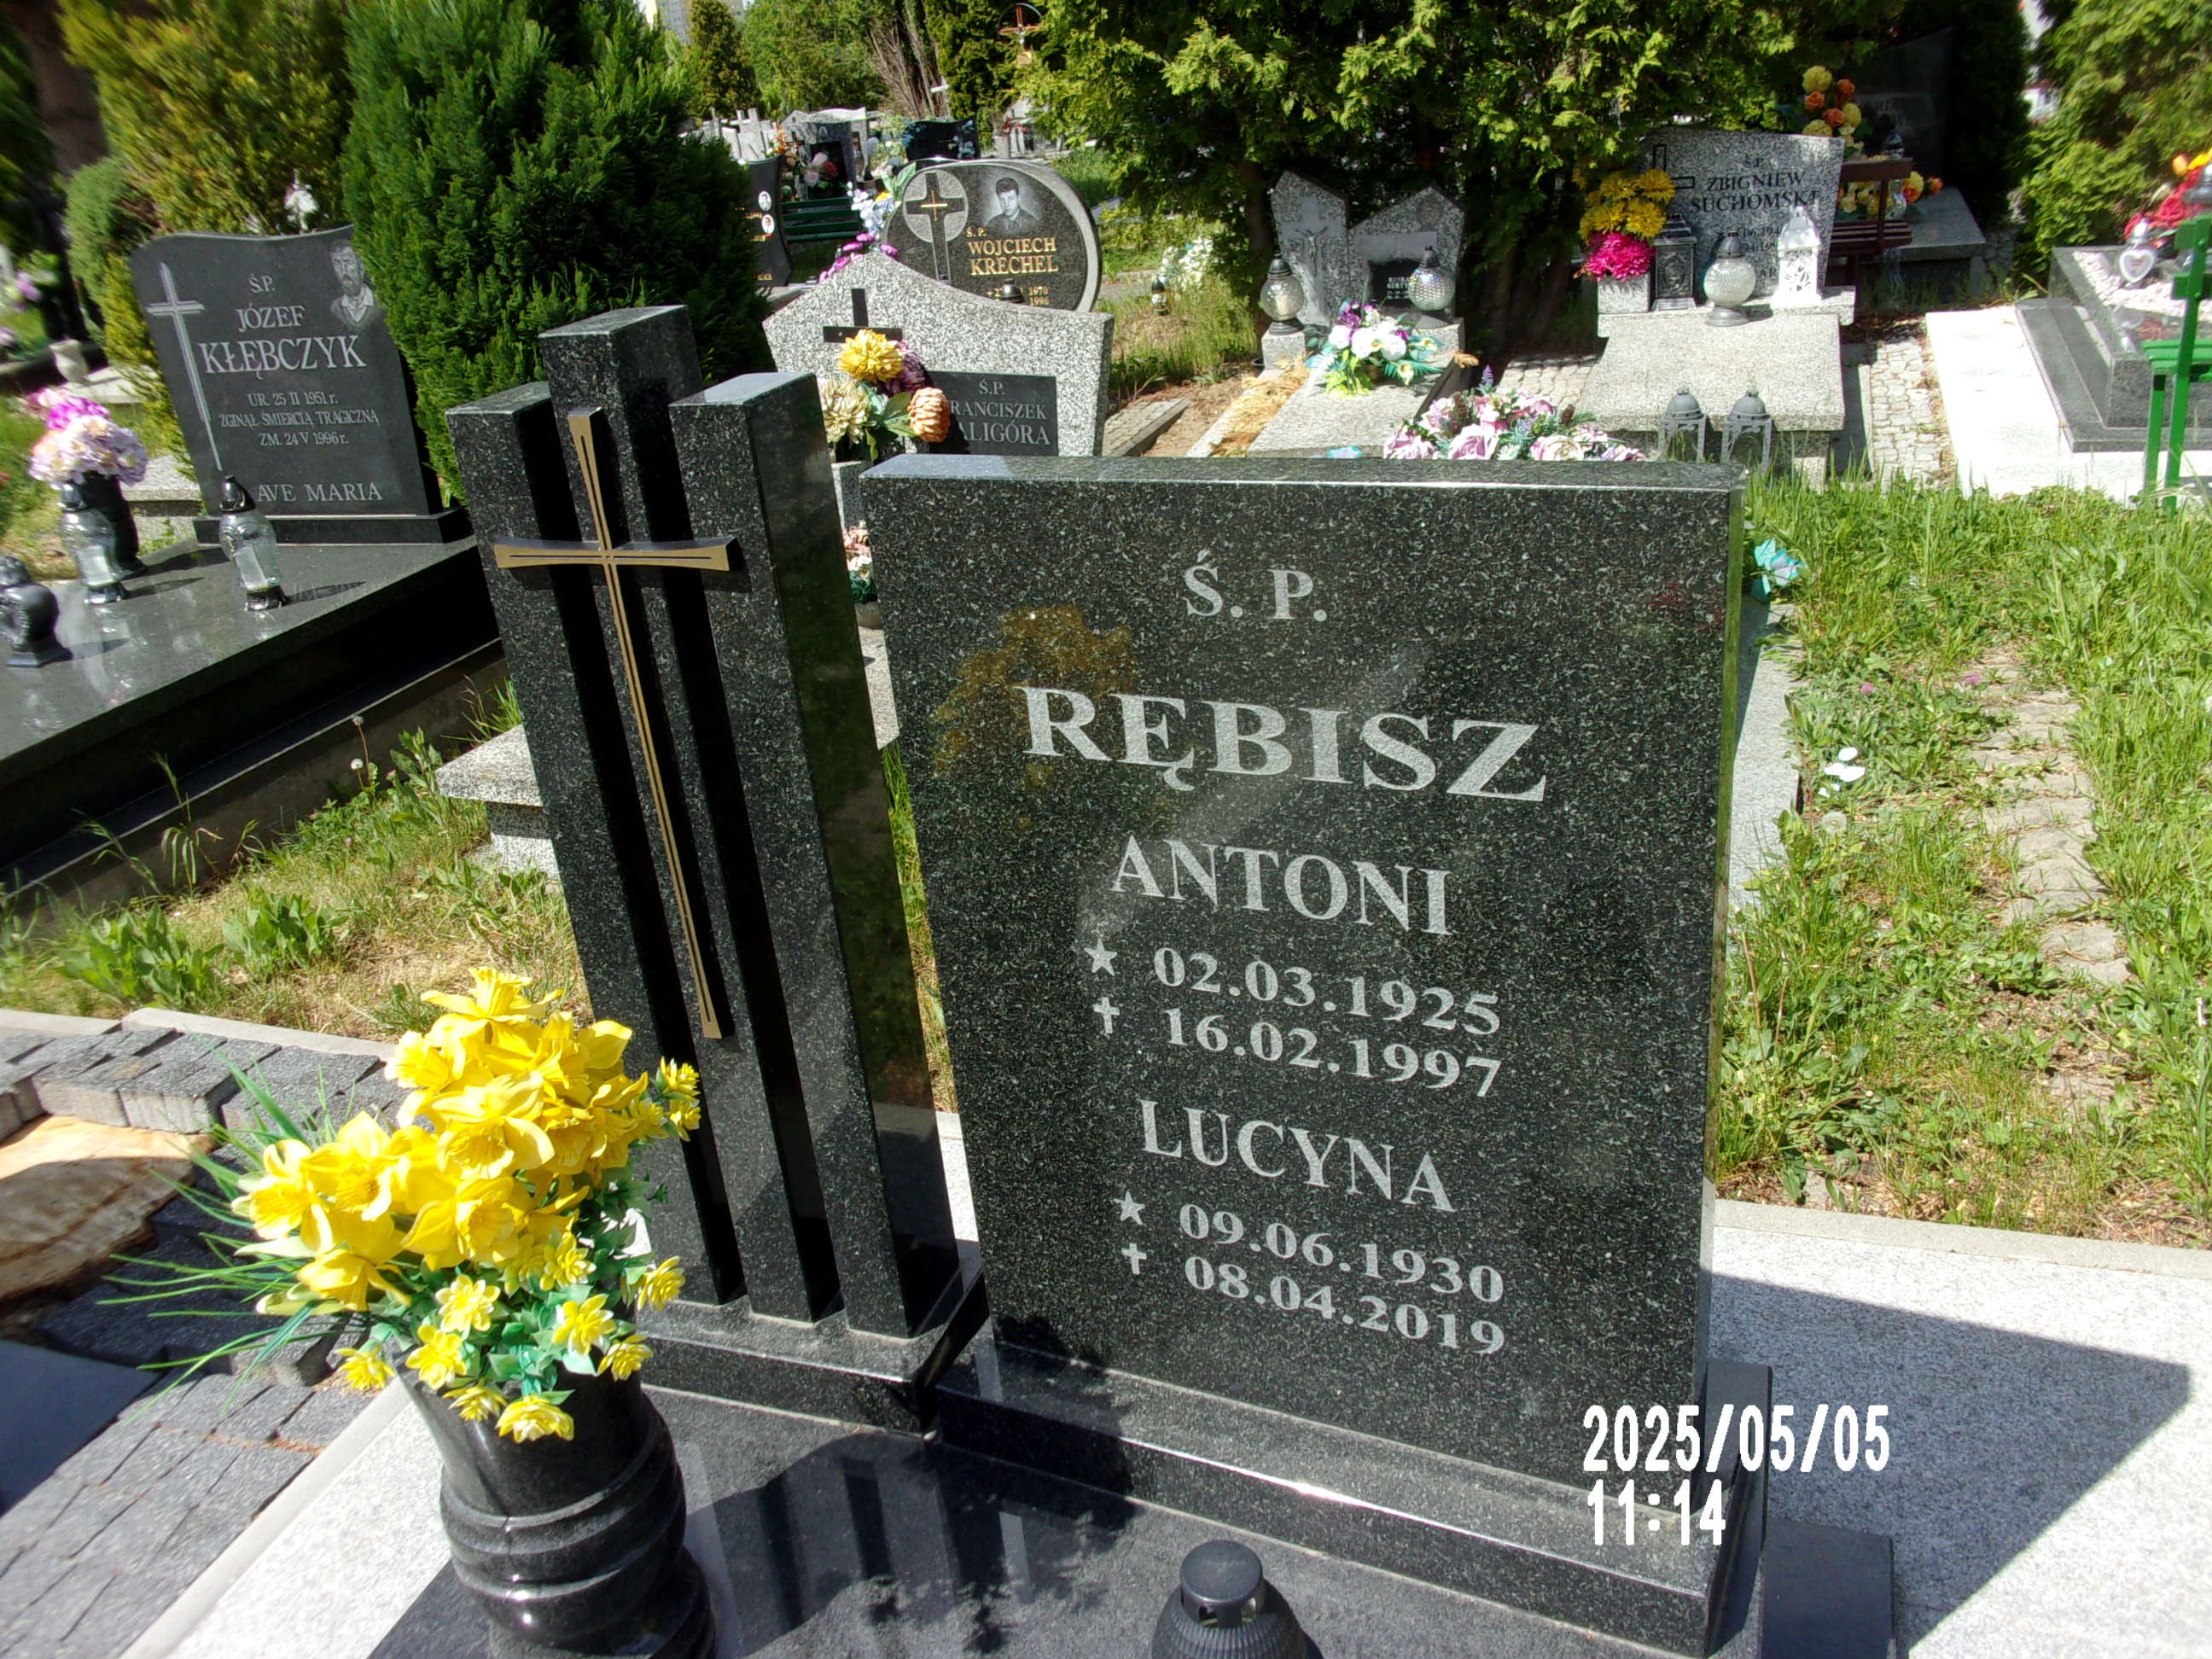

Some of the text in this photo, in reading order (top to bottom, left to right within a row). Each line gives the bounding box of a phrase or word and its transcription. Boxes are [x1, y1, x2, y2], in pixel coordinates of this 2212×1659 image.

[1707, 171, 1806, 192] ZBIGNIEW
[1690, 189, 1819, 213] SUCHOMSKI
[967, 237, 1057, 255] WOJCIECH
[969, 255, 1059, 276] KRECHEL
[235, 303, 306, 333] JÓZEF
[197, 335, 367, 380] KŁĘBCZYK
[979, 378, 1005, 395] Ś.P.
[272, 393, 287, 406] 25
[290, 392, 300, 405] II
[304, 392, 328, 405] 1951
[951, 399, 1047, 419] RANCISZEK
[261, 410, 313, 428] ŚMIERCIĄ
[316, 409, 381, 426] TRAGICZNĄ
[284, 432, 299, 445] 24
[300, 432, 309, 445] V
[312, 431, 339, 445] 1996
[257, 482, 383, 502] AVE MARIA
[1016, 685, 1546, 802] RĘBISZ
[1112, 835, 1452, 936] ANTONI
[1154, 947, 1501, 1035] 02.03.1925
[1163, 1008, 1502, 1097] 16.02.1997
[1137, 1098, 1456, 1213] LUCYNA
[1179, 1203, 1504, 1302] 09.06.1930
[1184, 1255, 1505, 1354] 08.04.2019
